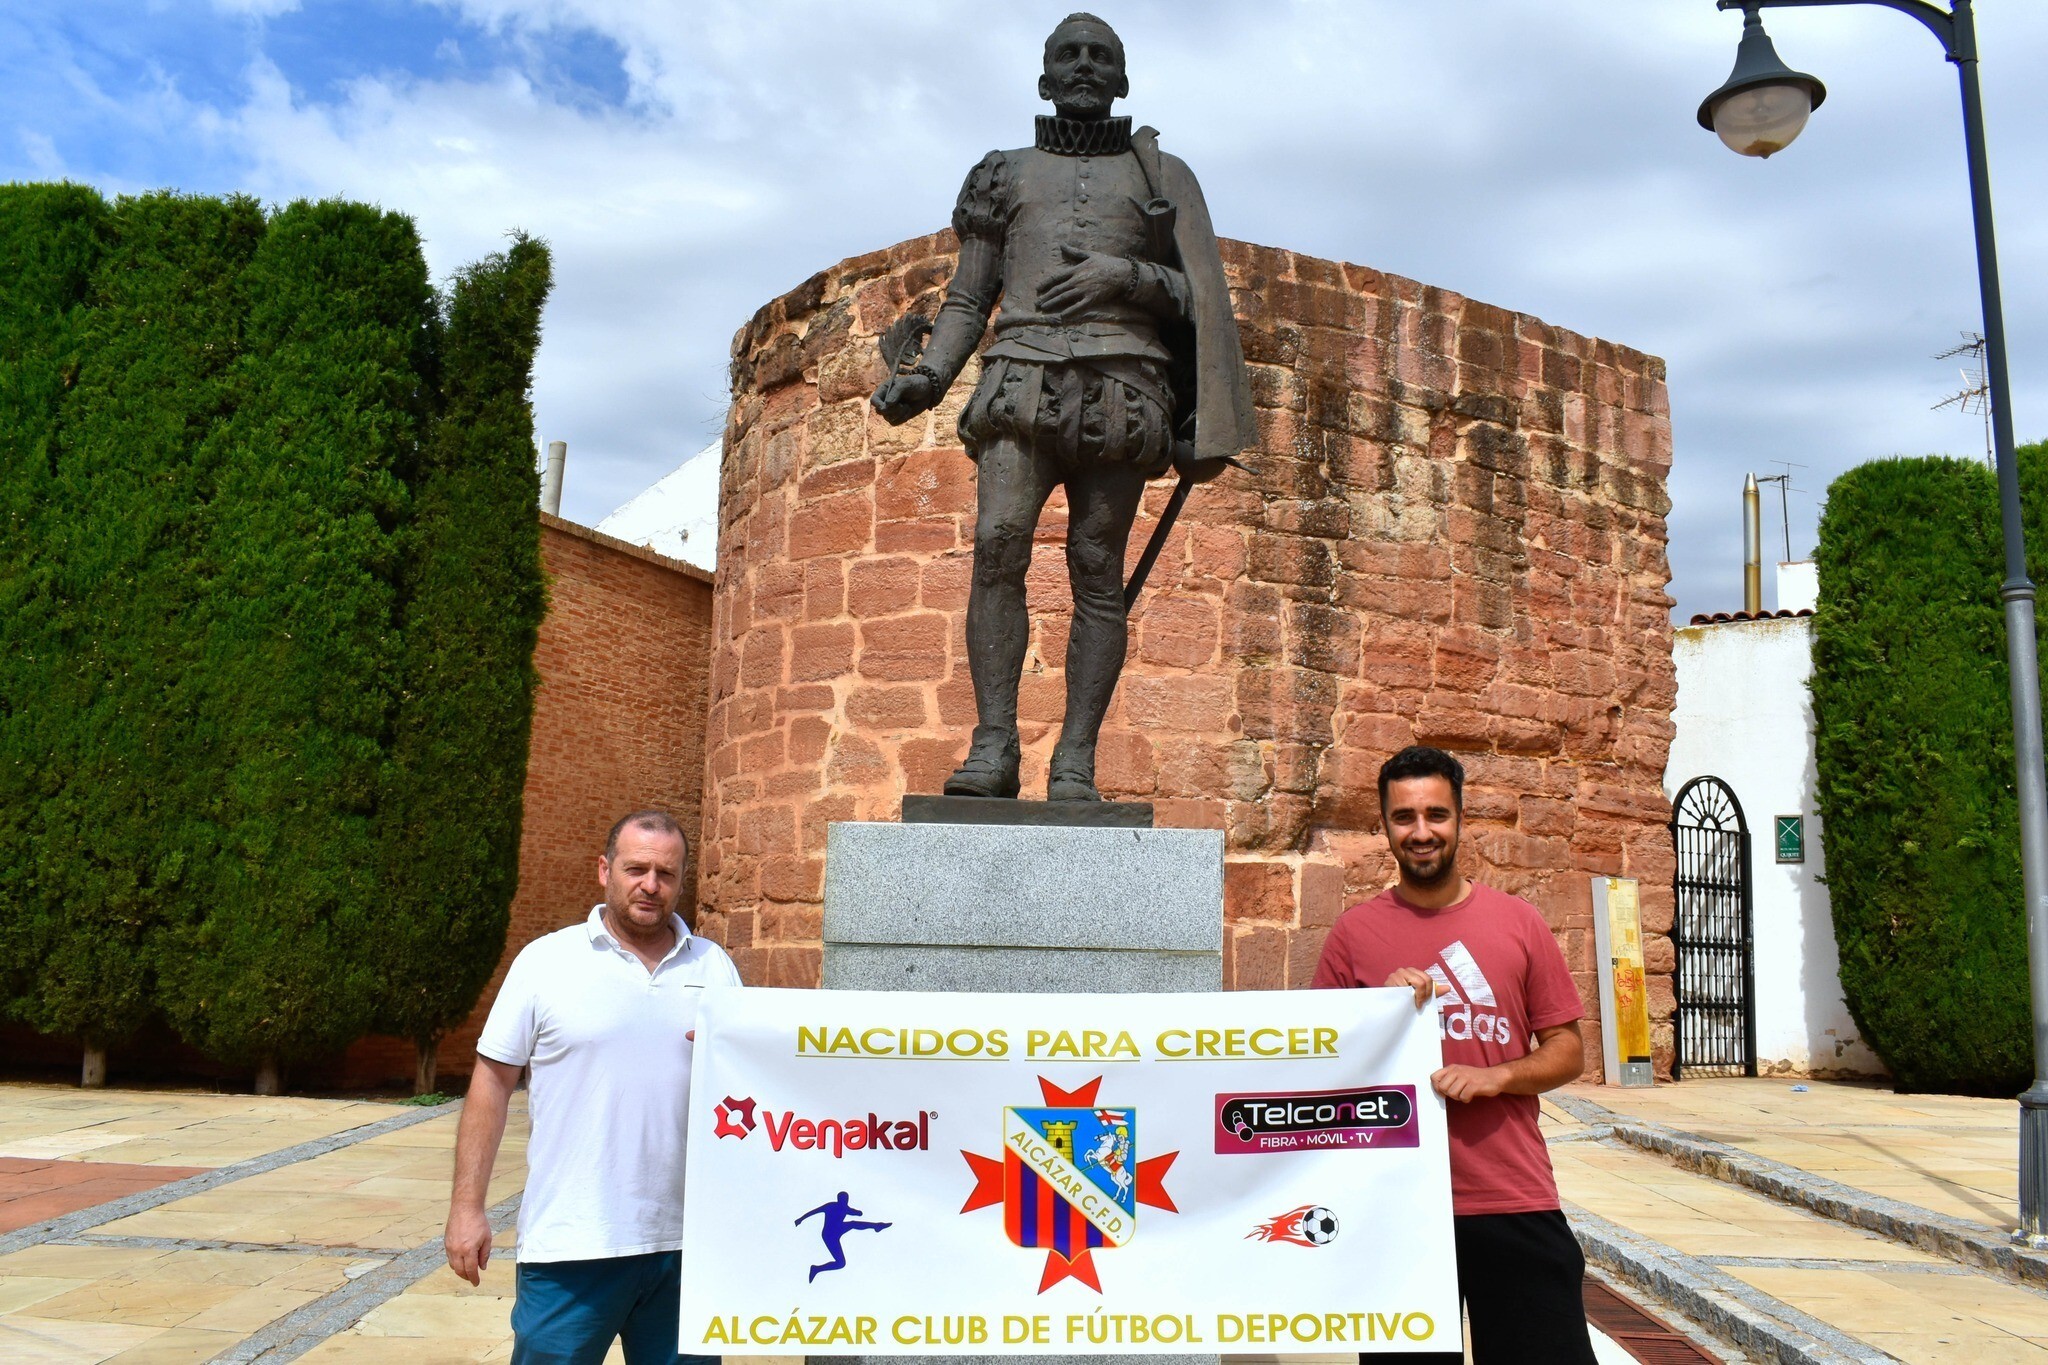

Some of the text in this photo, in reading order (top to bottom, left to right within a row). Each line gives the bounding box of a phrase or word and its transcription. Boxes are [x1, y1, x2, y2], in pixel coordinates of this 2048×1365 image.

[797, 1026, 1339, 1057] NACIDOS PARA CRECER
[1260, 1132, 1374, 1148] FIBRA MÓVIL TV
[1010, 1131, 1083, 1198] ALCÁZAR
[701, 1306, 1435, 1345] ALCÁZAR CLUB DE FÚTBOL DEPORTIVO
